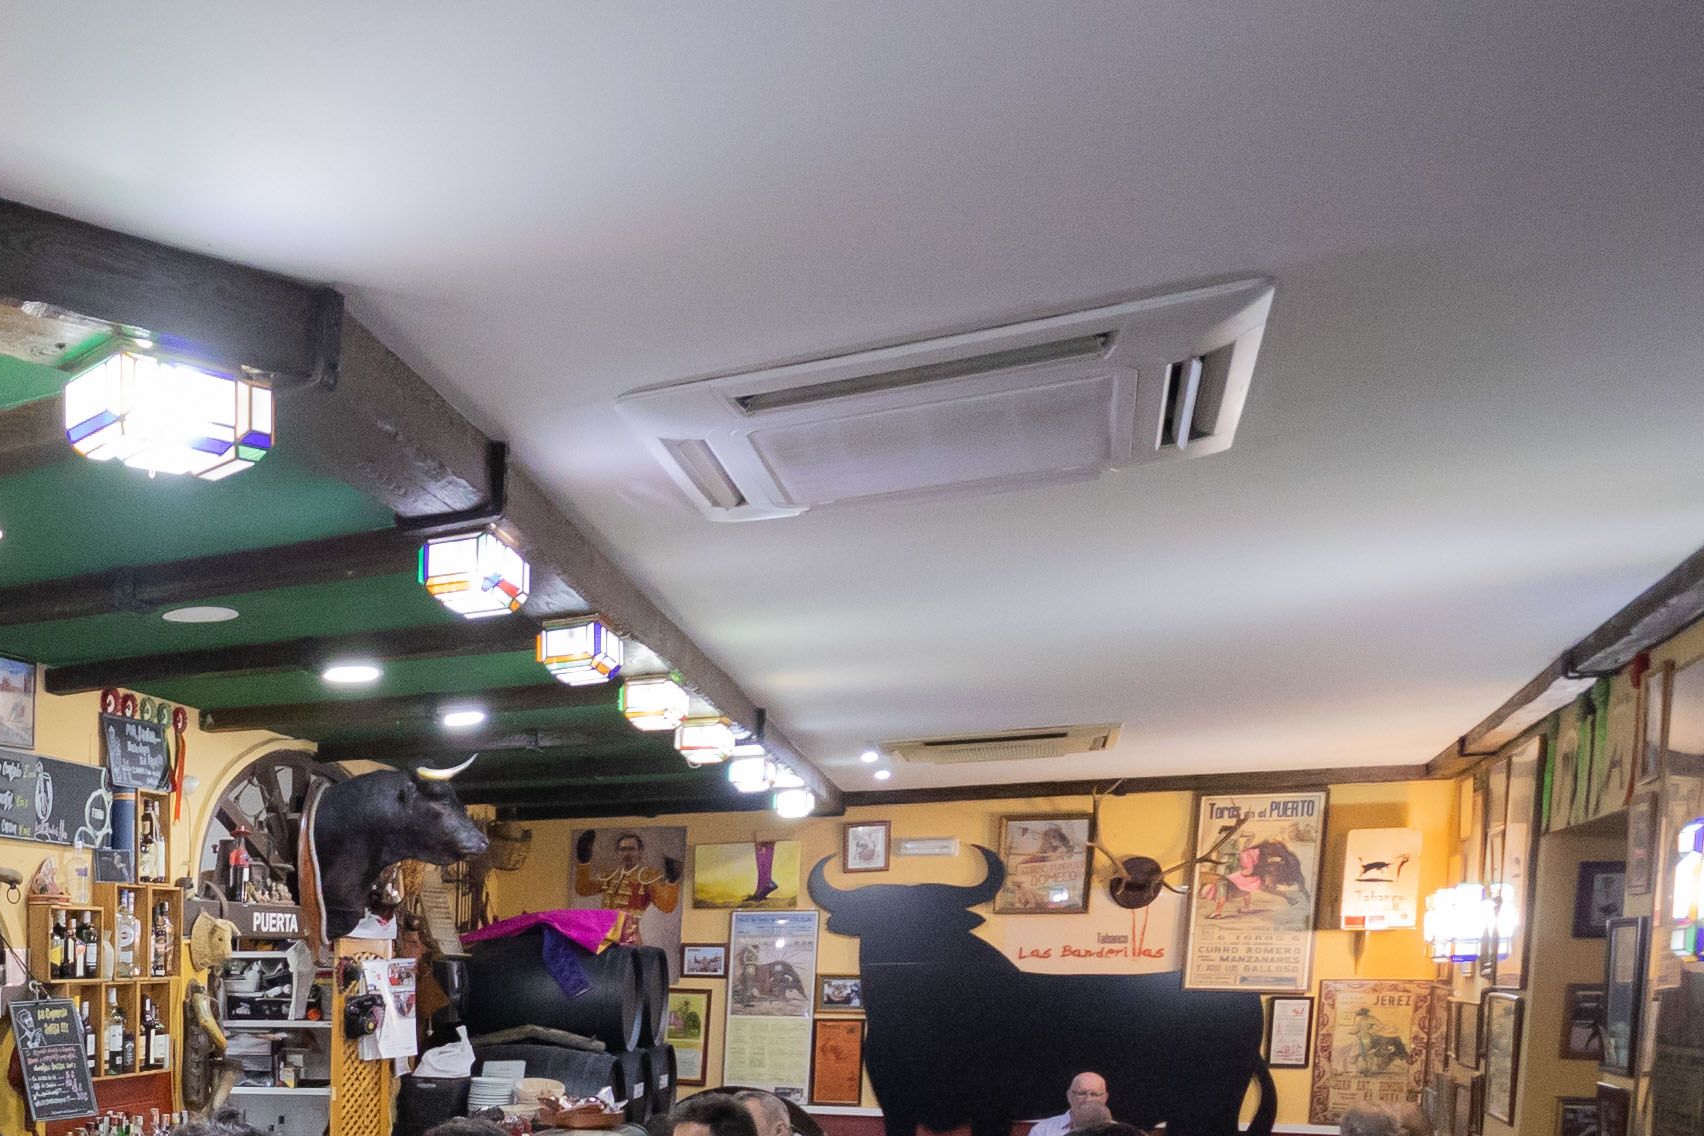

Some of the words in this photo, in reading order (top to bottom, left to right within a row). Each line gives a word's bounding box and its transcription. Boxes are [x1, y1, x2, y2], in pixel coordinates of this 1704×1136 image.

[1269, 800, 1316, 818] PUERTO
[252, 911, 299, 933] PUERTA
[1018, 947, 1053, 960] Las
[1374, 994, 1412, 1007] JEREZ
